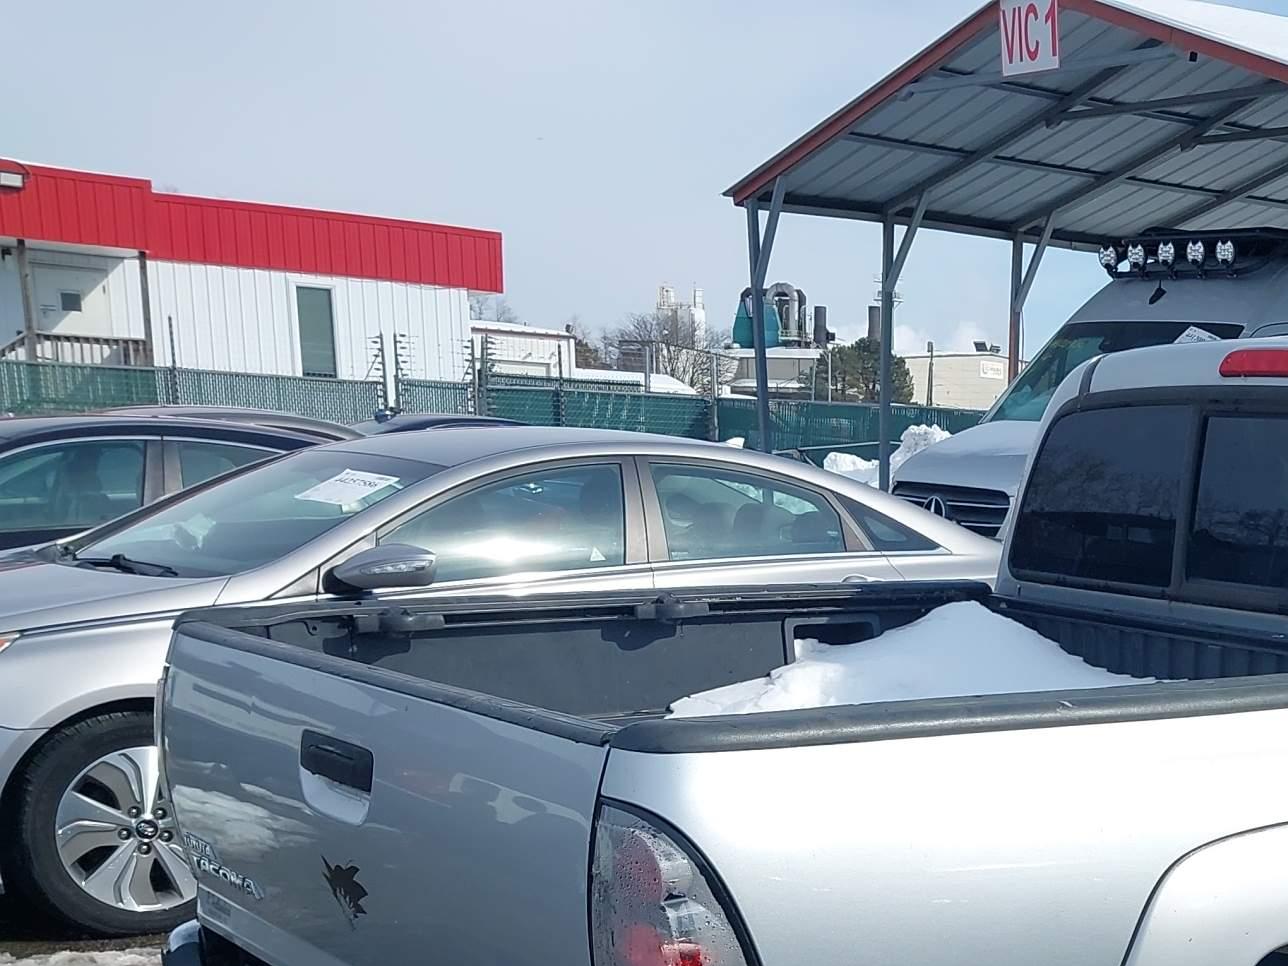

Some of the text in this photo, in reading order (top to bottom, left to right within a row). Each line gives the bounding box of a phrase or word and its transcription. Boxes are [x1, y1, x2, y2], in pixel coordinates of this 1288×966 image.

[1002, 0, 1057, 64] VIC 1
[192, 850, 264, 900] TACOMA
